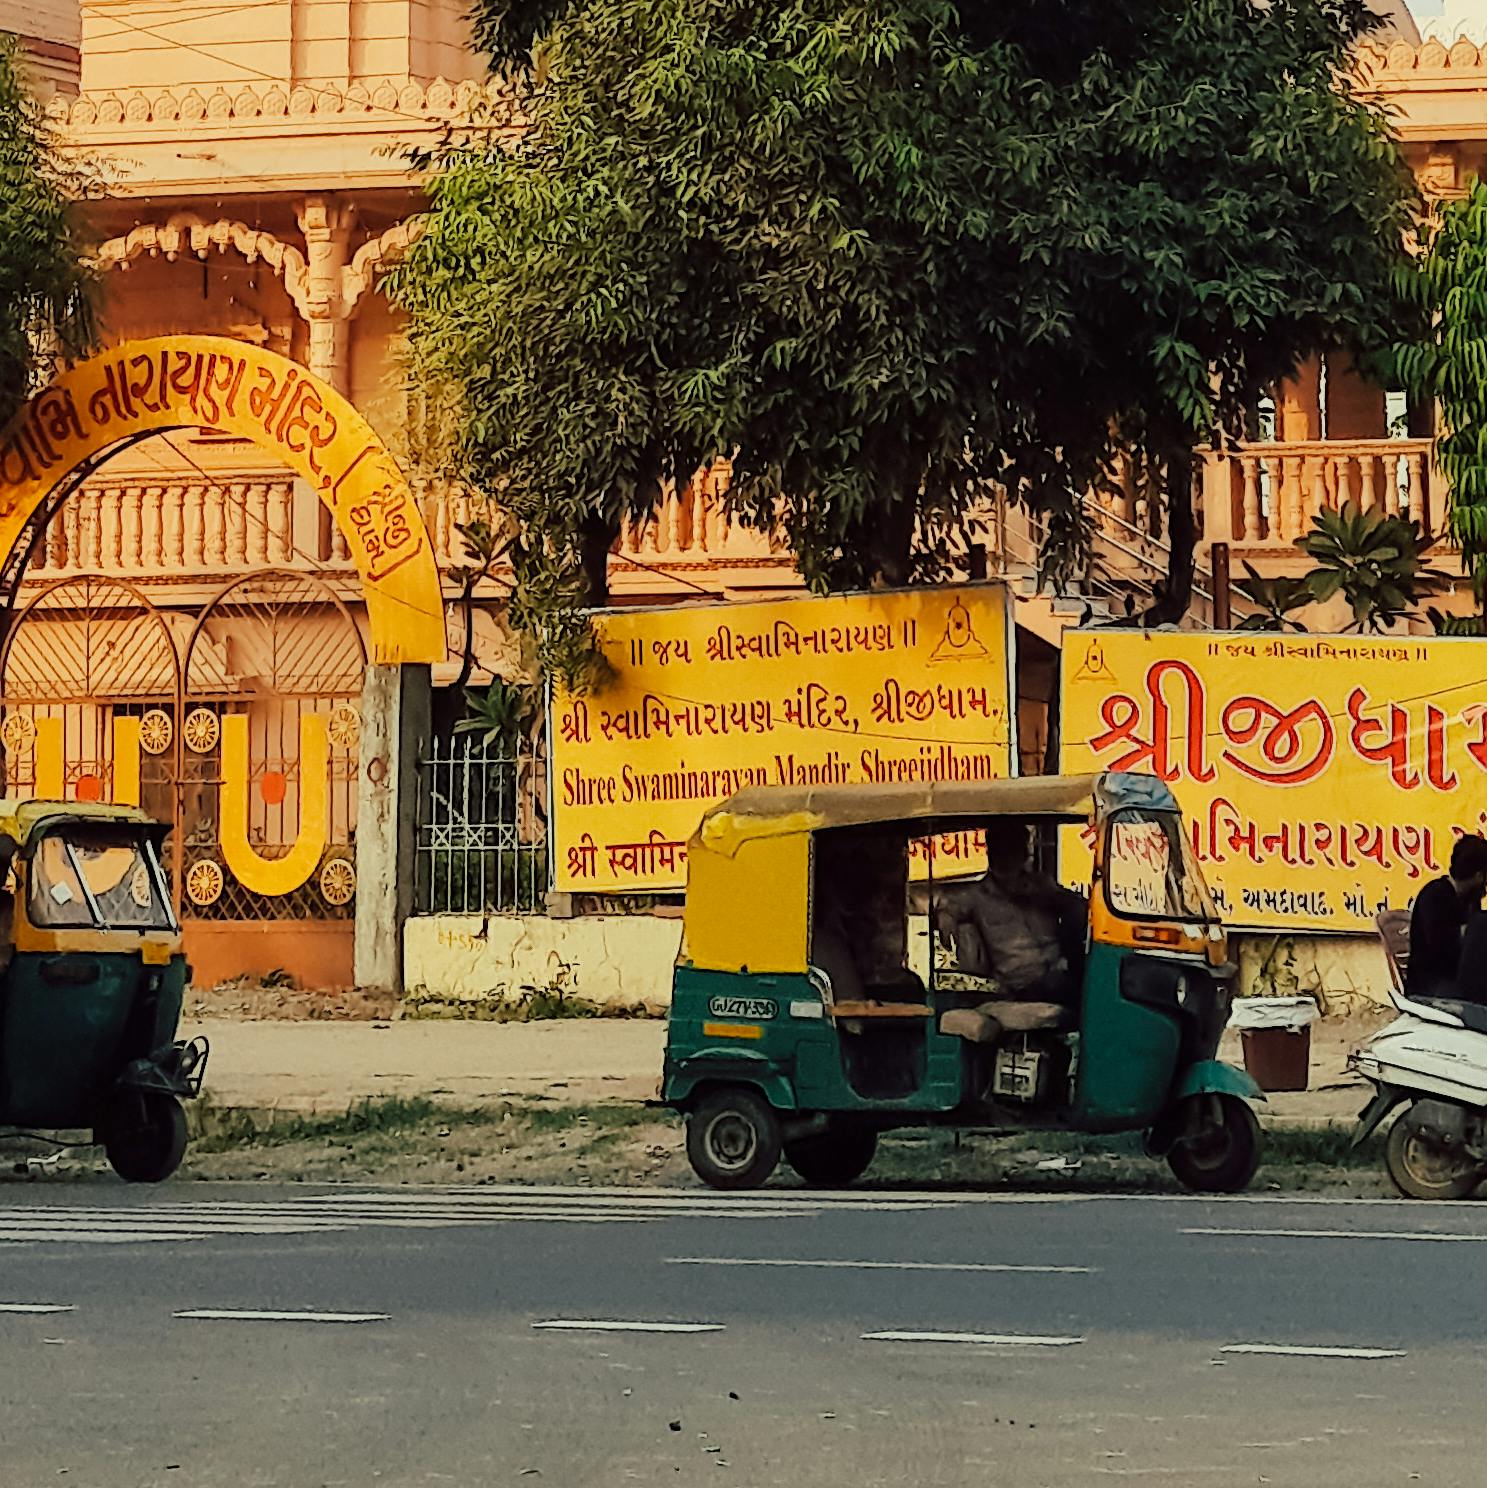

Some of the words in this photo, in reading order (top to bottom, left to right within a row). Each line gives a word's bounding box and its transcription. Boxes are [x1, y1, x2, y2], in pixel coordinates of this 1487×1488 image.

[560, 700, 592, 744] શ્રી
[600, 693, 774, 741] સ્વામિનારાયણ
[563, 767, 616, 807] Shree
[622, 758, 768, 803] Swaminarayan
[567, 832, 599, 878] श्री
